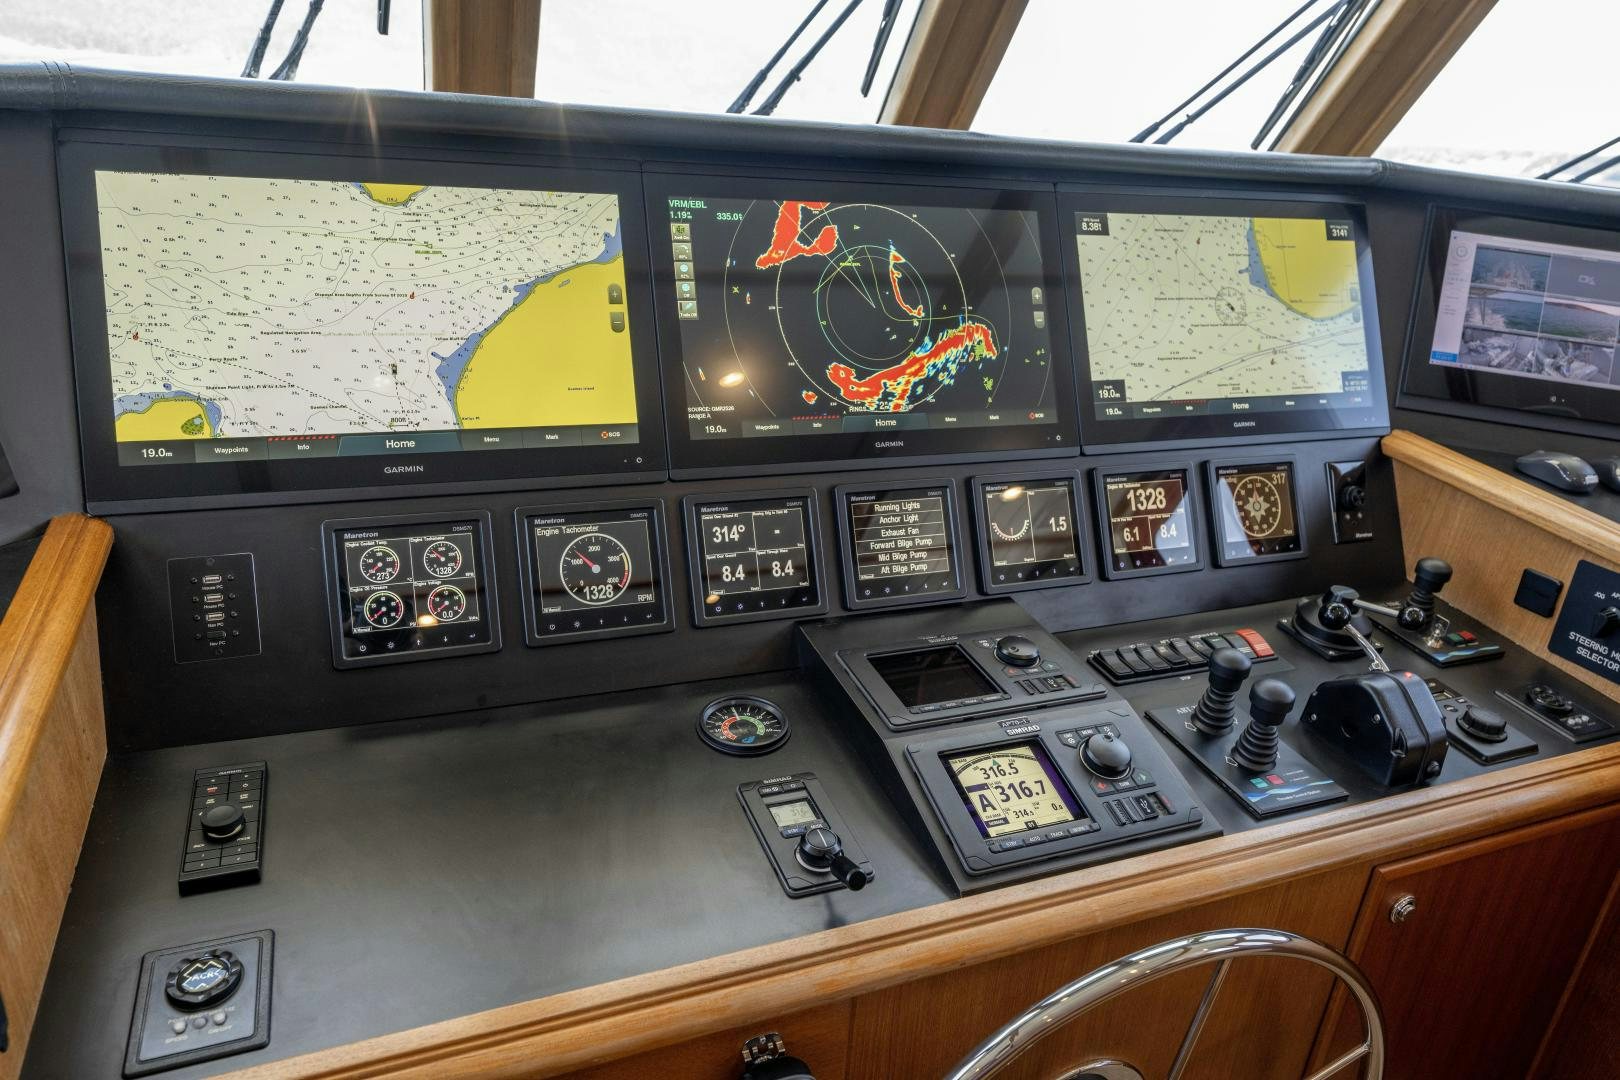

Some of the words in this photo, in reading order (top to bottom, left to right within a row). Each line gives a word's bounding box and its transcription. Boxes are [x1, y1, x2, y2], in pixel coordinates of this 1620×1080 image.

[668, 200, 707, 208] VRM/EBL
[214, 446, 248, 454] Waypoints
[386, 438, 416, 449] Home
[384, 465, 424, 474] GARMIN
[1272, 474, 1286, 485] 317
[902, 502, 920, 510] Lights
[1127, 488, 1166, 511] 1328
[904, 514, 919, 523] Light
[1049, 516, 1067, 532] 1.5
[537, 528, 559, 536] Engine
[562, 525, 599, 534] Tachometer
[881, 529, 905, 537] Exhaust
[1124, 526, 1139, 542] 6.1
[1160, 523, 1176, 538] 8.4
[870, 541, 895, 550] Forward
[898, 540, 913, 548] Bilge
[722, 564, 745, 582] 8.4
[772, 560, 794, 577] 8.4
[584, 584, 614, 600] 1328
[1569, 632, 1608, 655] STEERING
[1576, 647, 1620, 672] SELECTOR
[1007, 725, 1040, 735] SIMRAD
[980, 762, 1019, 780] 316.5
[993, 780, 1046, 803] 316.7
[978, 794, 997, 812] A
